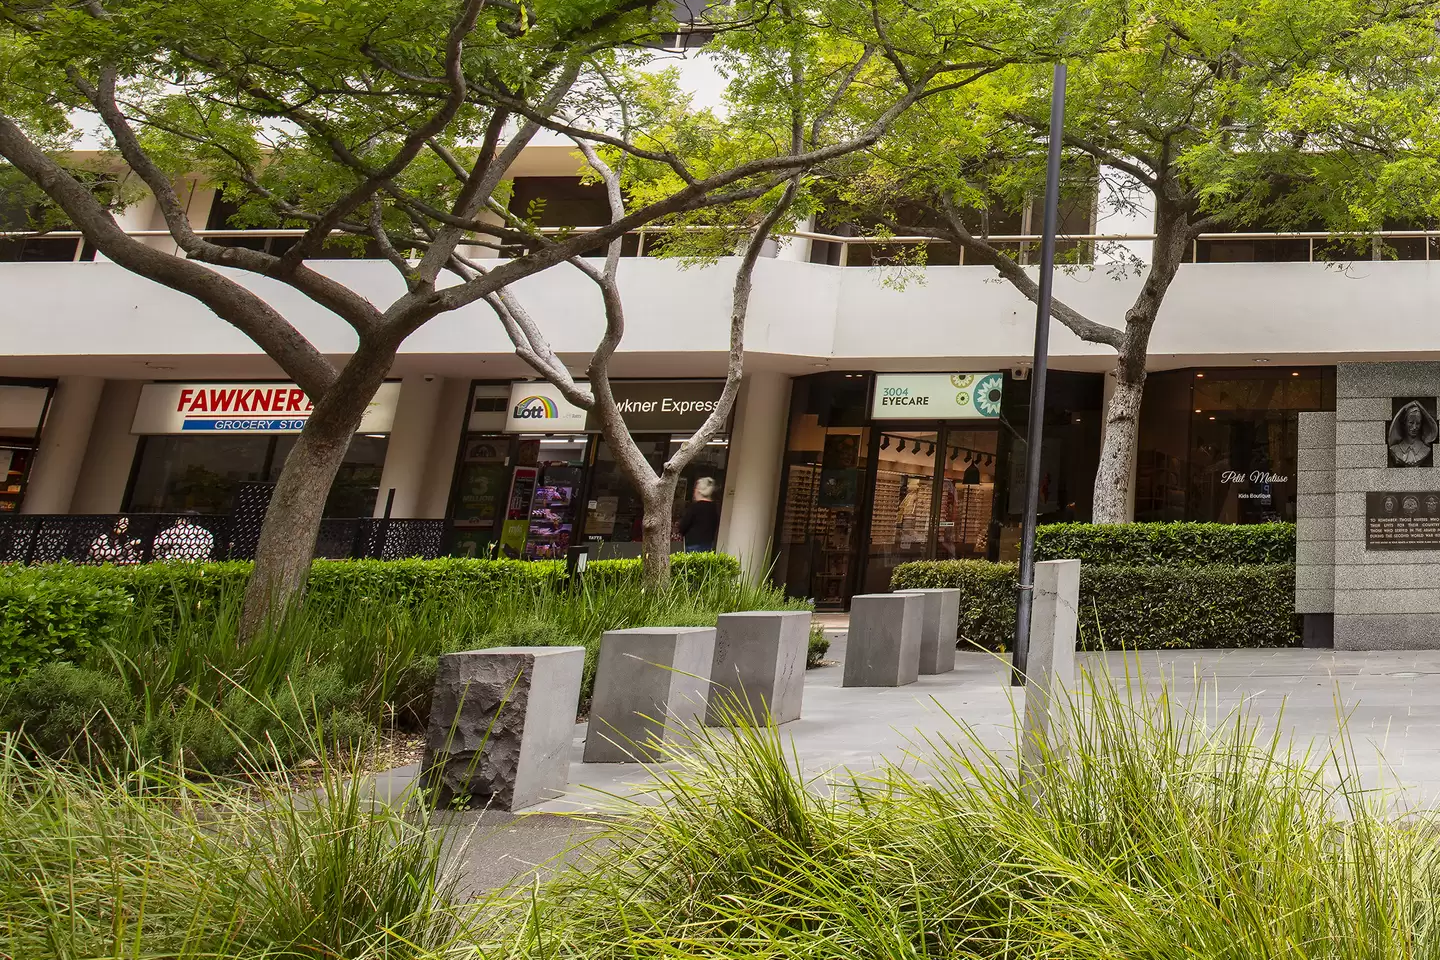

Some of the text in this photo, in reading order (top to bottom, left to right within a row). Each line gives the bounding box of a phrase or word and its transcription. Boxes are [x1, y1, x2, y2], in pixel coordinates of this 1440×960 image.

[883, 387, 909, 397] 3004
[177, 388, 305, 413] FAWKNER
[615, 398, 658, 413] wkner
[882, 396, 930, 406] EYECARE
[214, 419, 306, 430] GROCERY STO
[1220, 469, 1289, 484] Petit Matisse
[1249, 492, 1271, 500] Boutique
